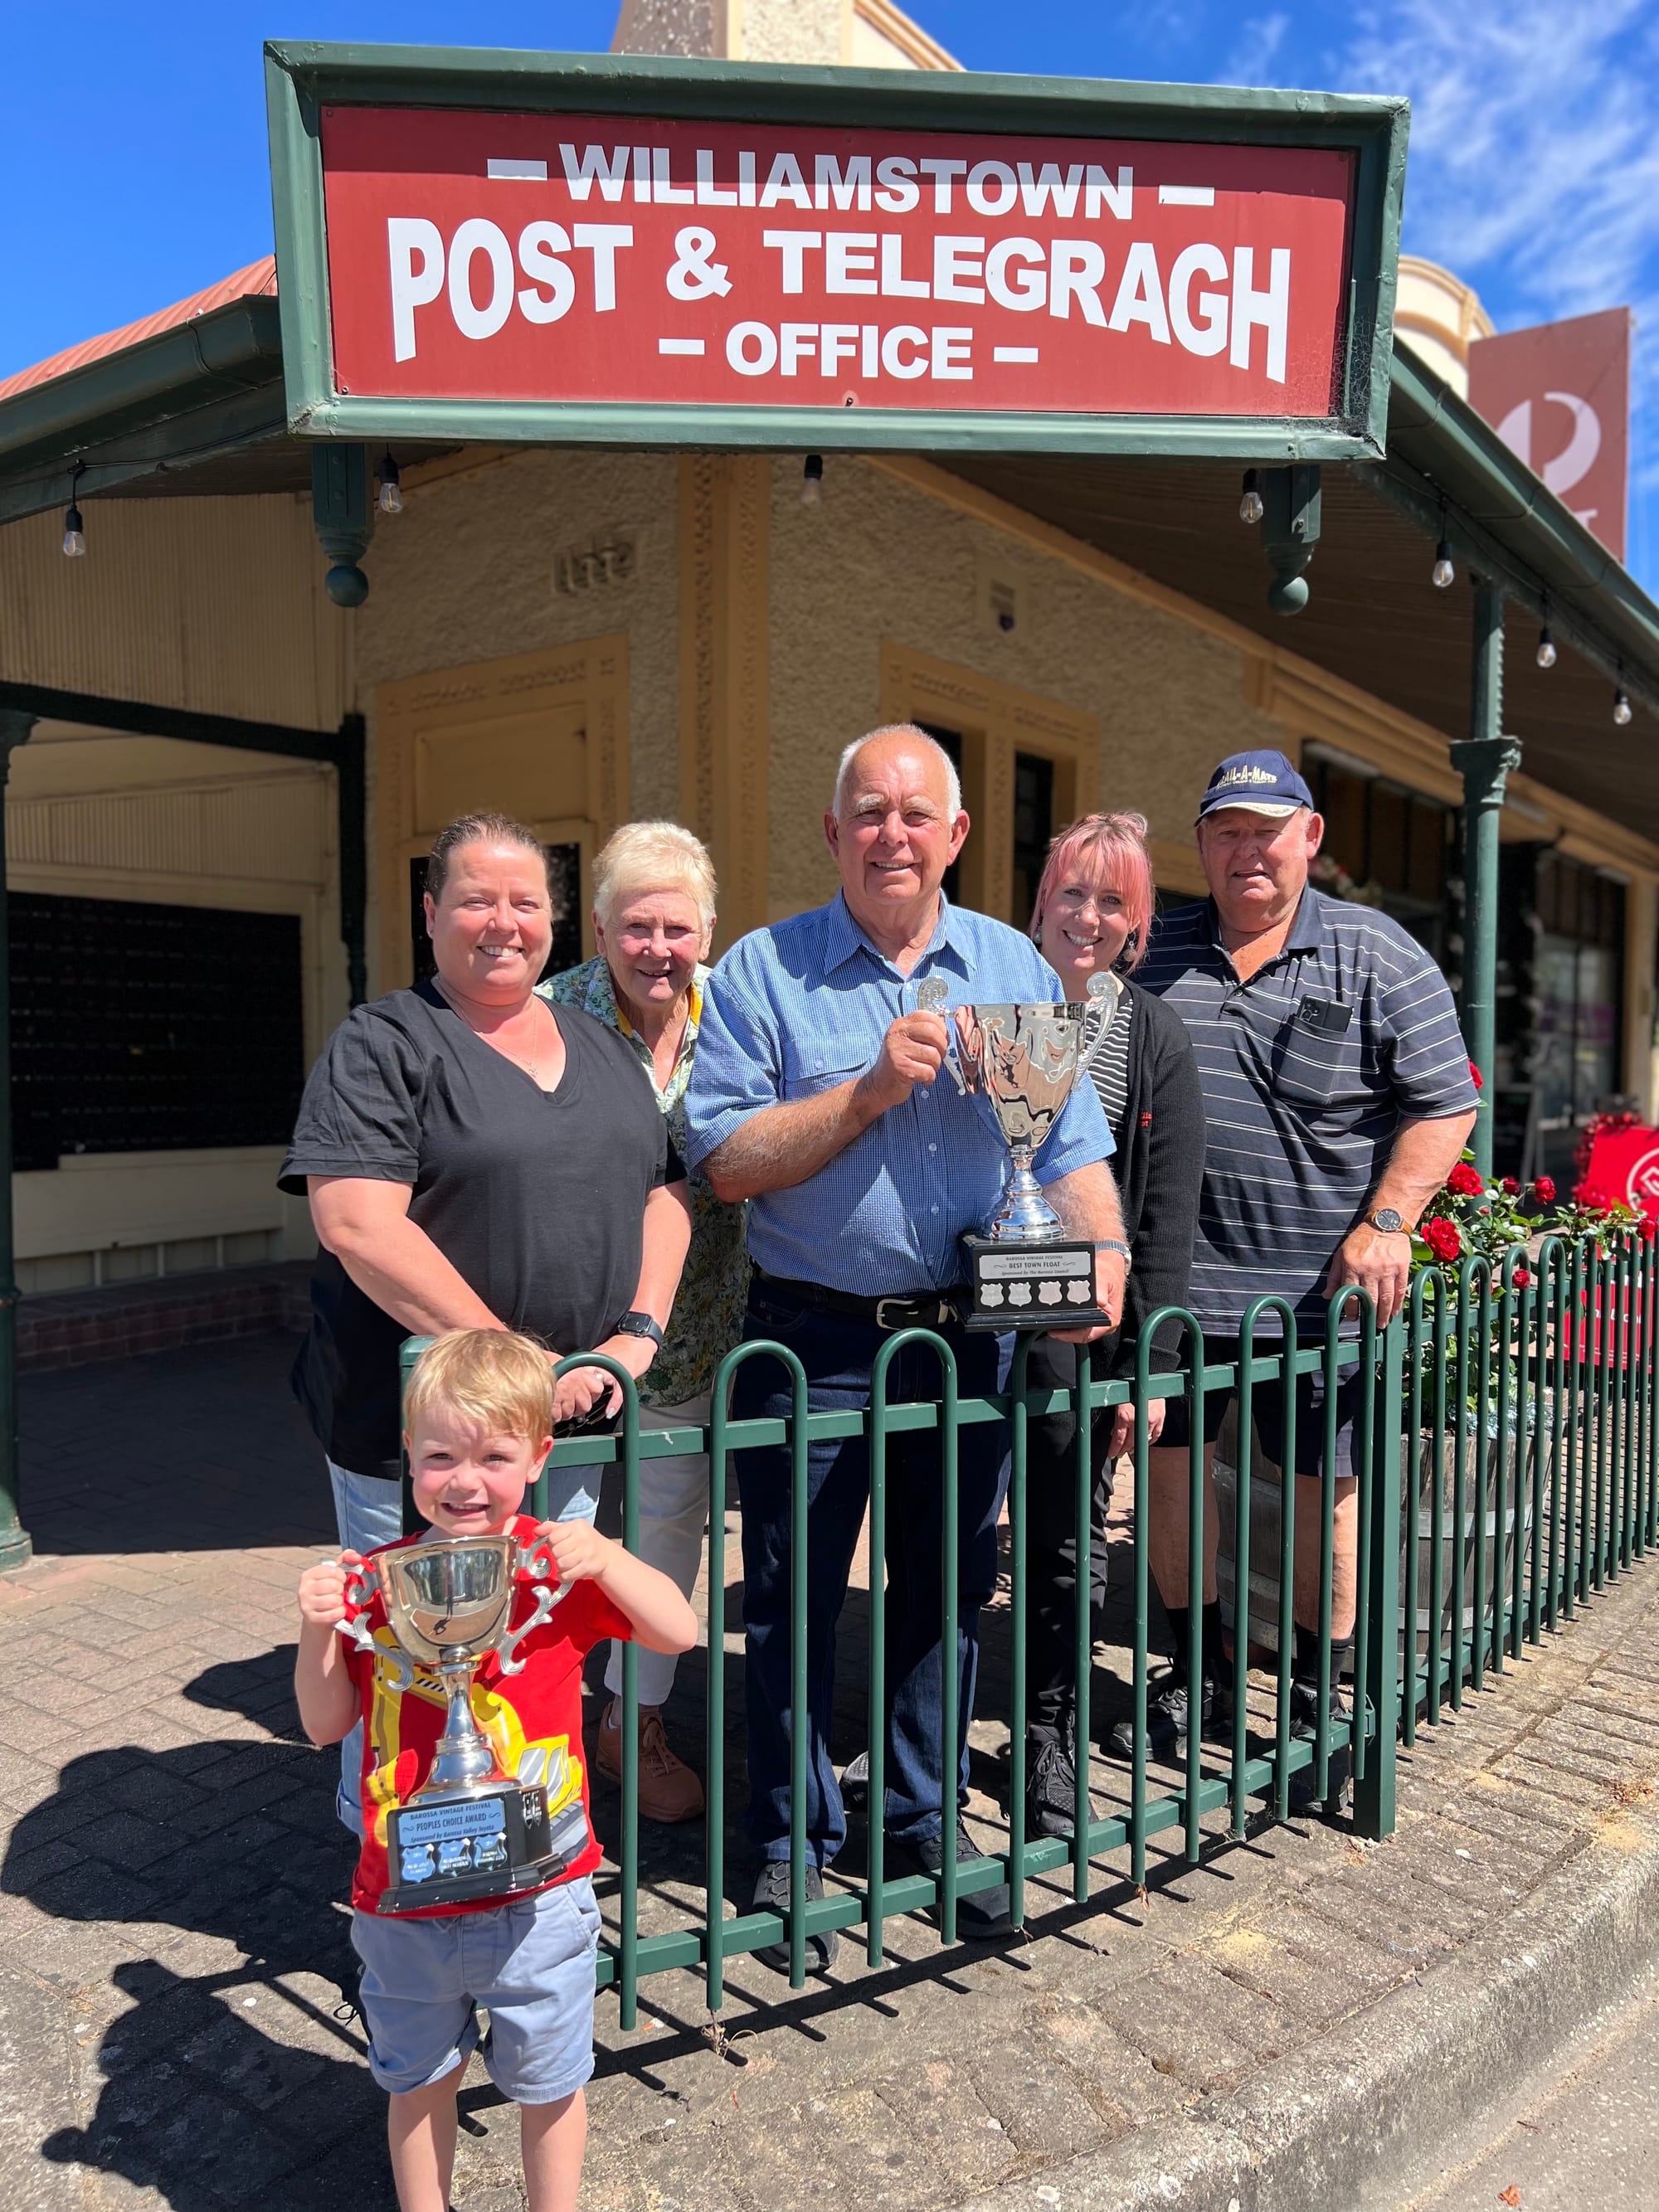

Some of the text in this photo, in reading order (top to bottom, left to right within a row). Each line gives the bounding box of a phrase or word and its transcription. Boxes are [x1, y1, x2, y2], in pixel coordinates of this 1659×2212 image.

[558, 143, 1134, 221] WILLIAMSTOWN
[387, 216, 1292, 384] POST & TELEGRAGH
[725, 320, 974, 381] OFFICE
[411, 1802, 491, 1820] BAROSSA VINTAGE FESTIVAL
[416, 1813, 487, 1831] PEOPLES CHOICE AWARD
[411, 1833, 435, 1843] Sponsored
